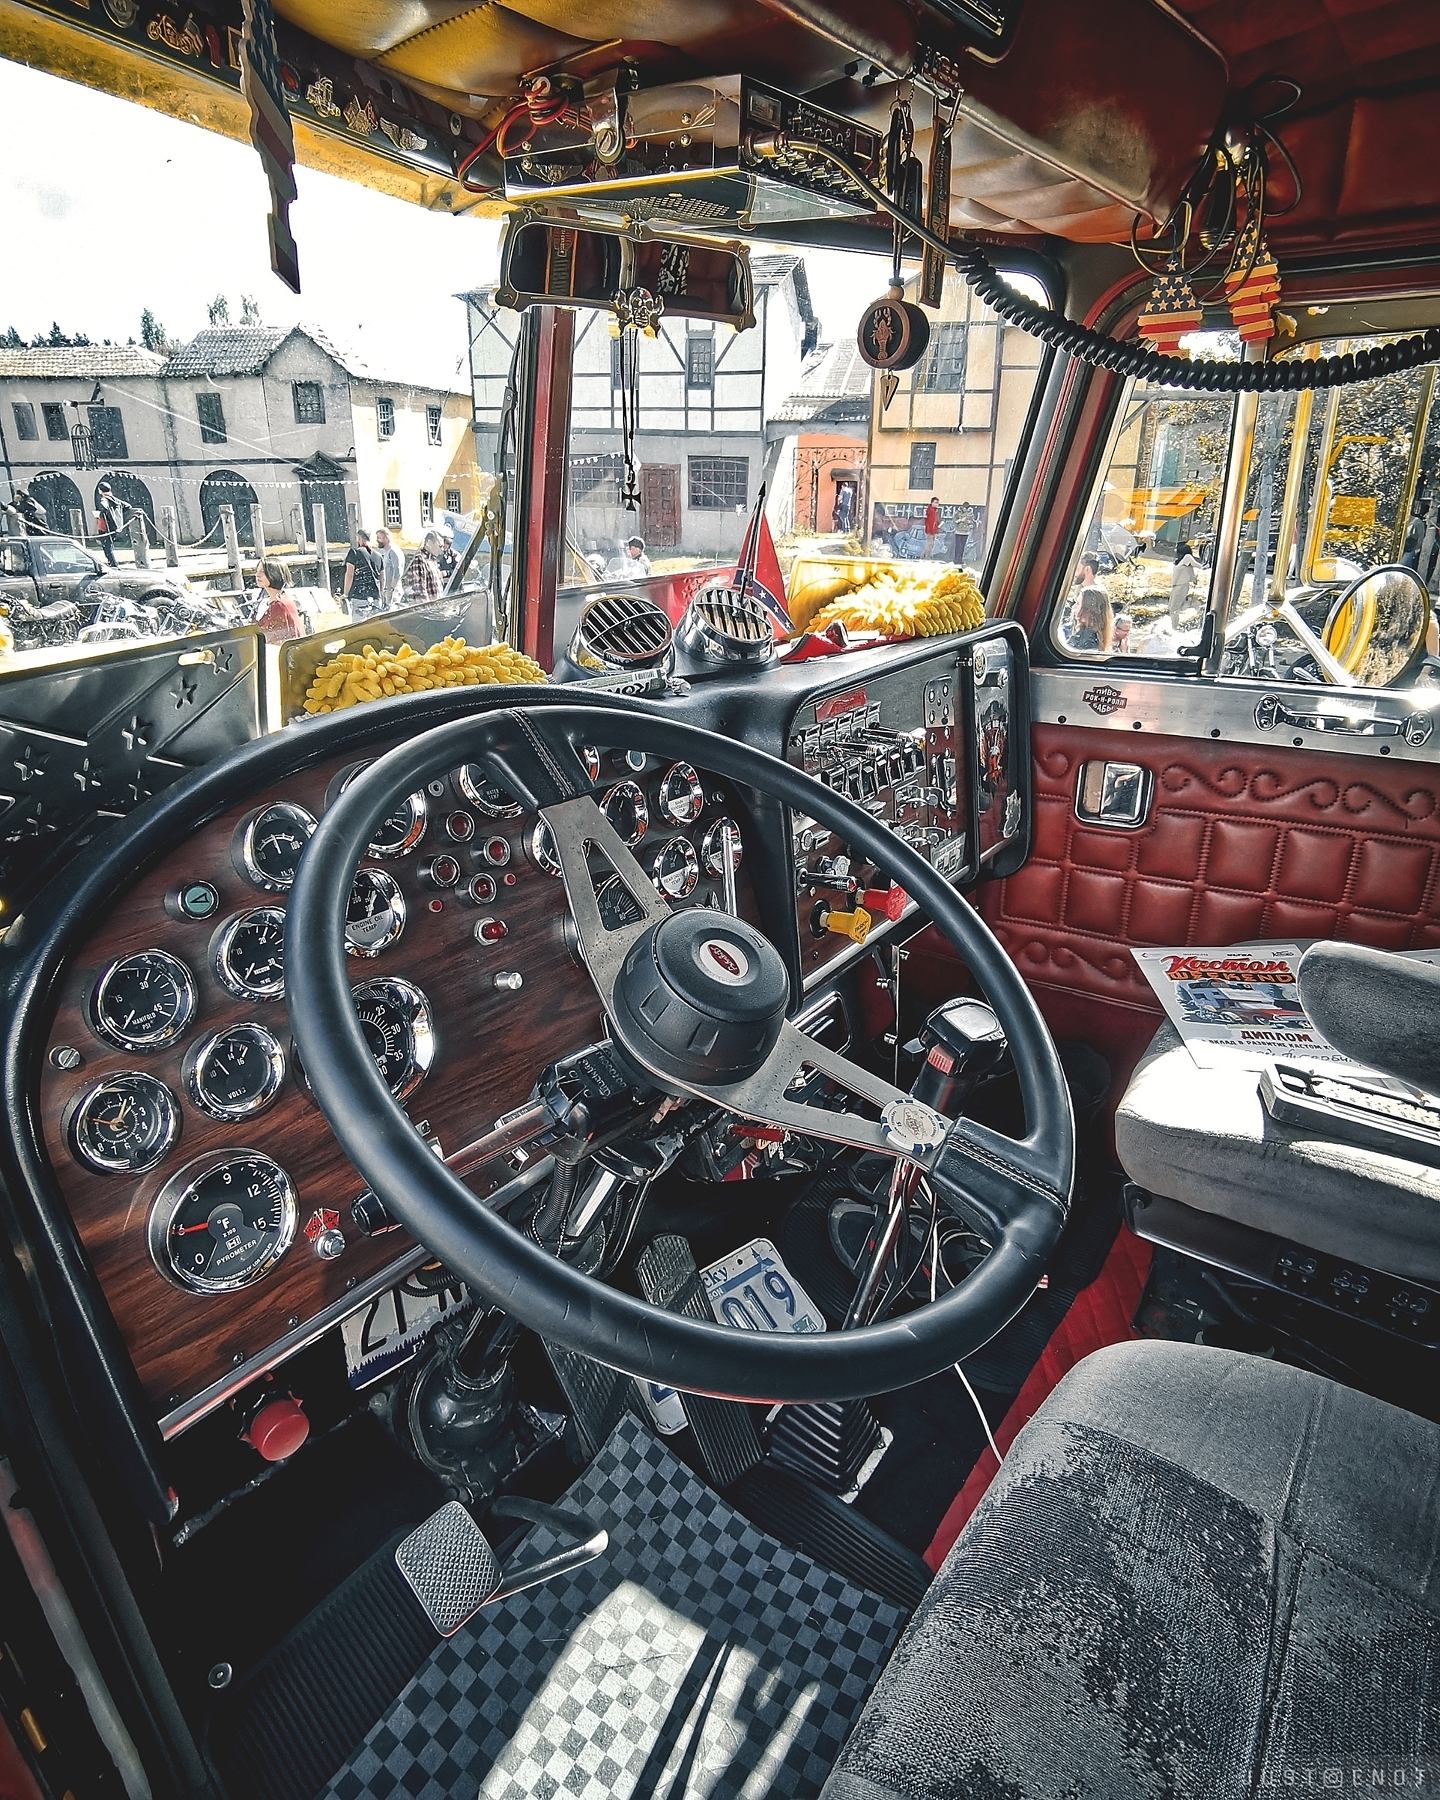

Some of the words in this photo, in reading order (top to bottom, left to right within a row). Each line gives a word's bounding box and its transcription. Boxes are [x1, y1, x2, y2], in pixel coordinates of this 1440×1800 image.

[352, 919, 374, 931] ENGINE
[374, 914, 384, 922] OIL
[362, 923, 378, 934] TEMP
[1170, 970, 1293, 983] WEEKEND
[139, 980, 149, 990] 30
[153, 1002, 163, 1012] 45
[132, 1012, 156, 1026] MANIFOLD
[390, 1023, 400, 1035] 30
[1240, 1030, 1313, 1043] ДИПЛОМ
[1246, 1040, 1288, 1048] РАЗВИТИЕ
[394, 1050, 404, 1062] 35
[228, 1086, 247, 1100] VOLTS
[139, 1106, 146, 1116] 3
[142, 1122, 148, 1131] 4
[134, 1134, 142, 1144] 5
[97, 1142, 104, 1152] 8
[222, 1172, 232, 1184] 9
[246, 1184, 261, 1198] 12
[252, 1216, 267, 1230] 15
[194, 1253, 204, 1264] 0
[216, 1239, 258, 1266] PYROMETER
